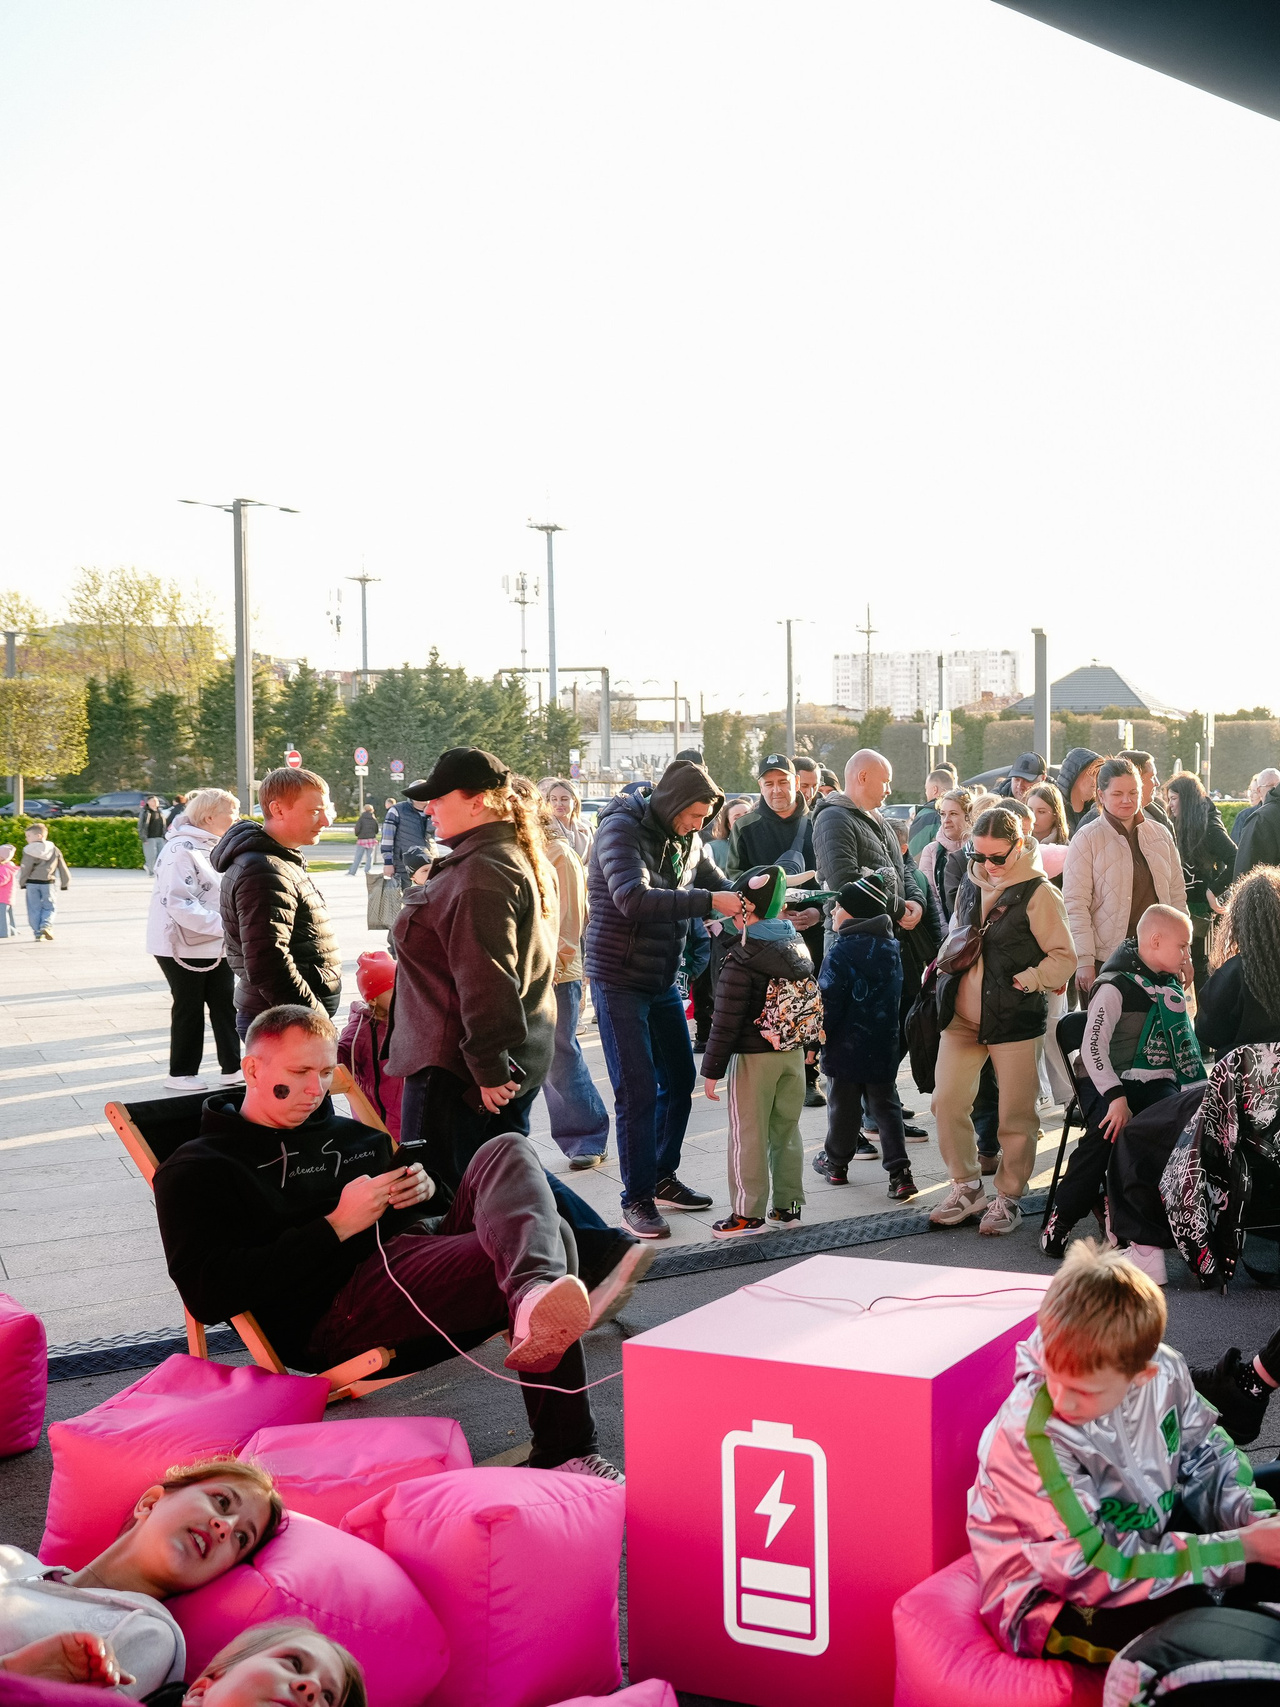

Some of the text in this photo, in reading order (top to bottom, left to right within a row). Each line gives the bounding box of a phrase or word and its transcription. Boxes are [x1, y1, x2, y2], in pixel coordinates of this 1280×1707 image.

[1090, 1007, 1105, 1071] ФК КРАСНОДАР
[257, 1138, 376, 1188] Talented Society
